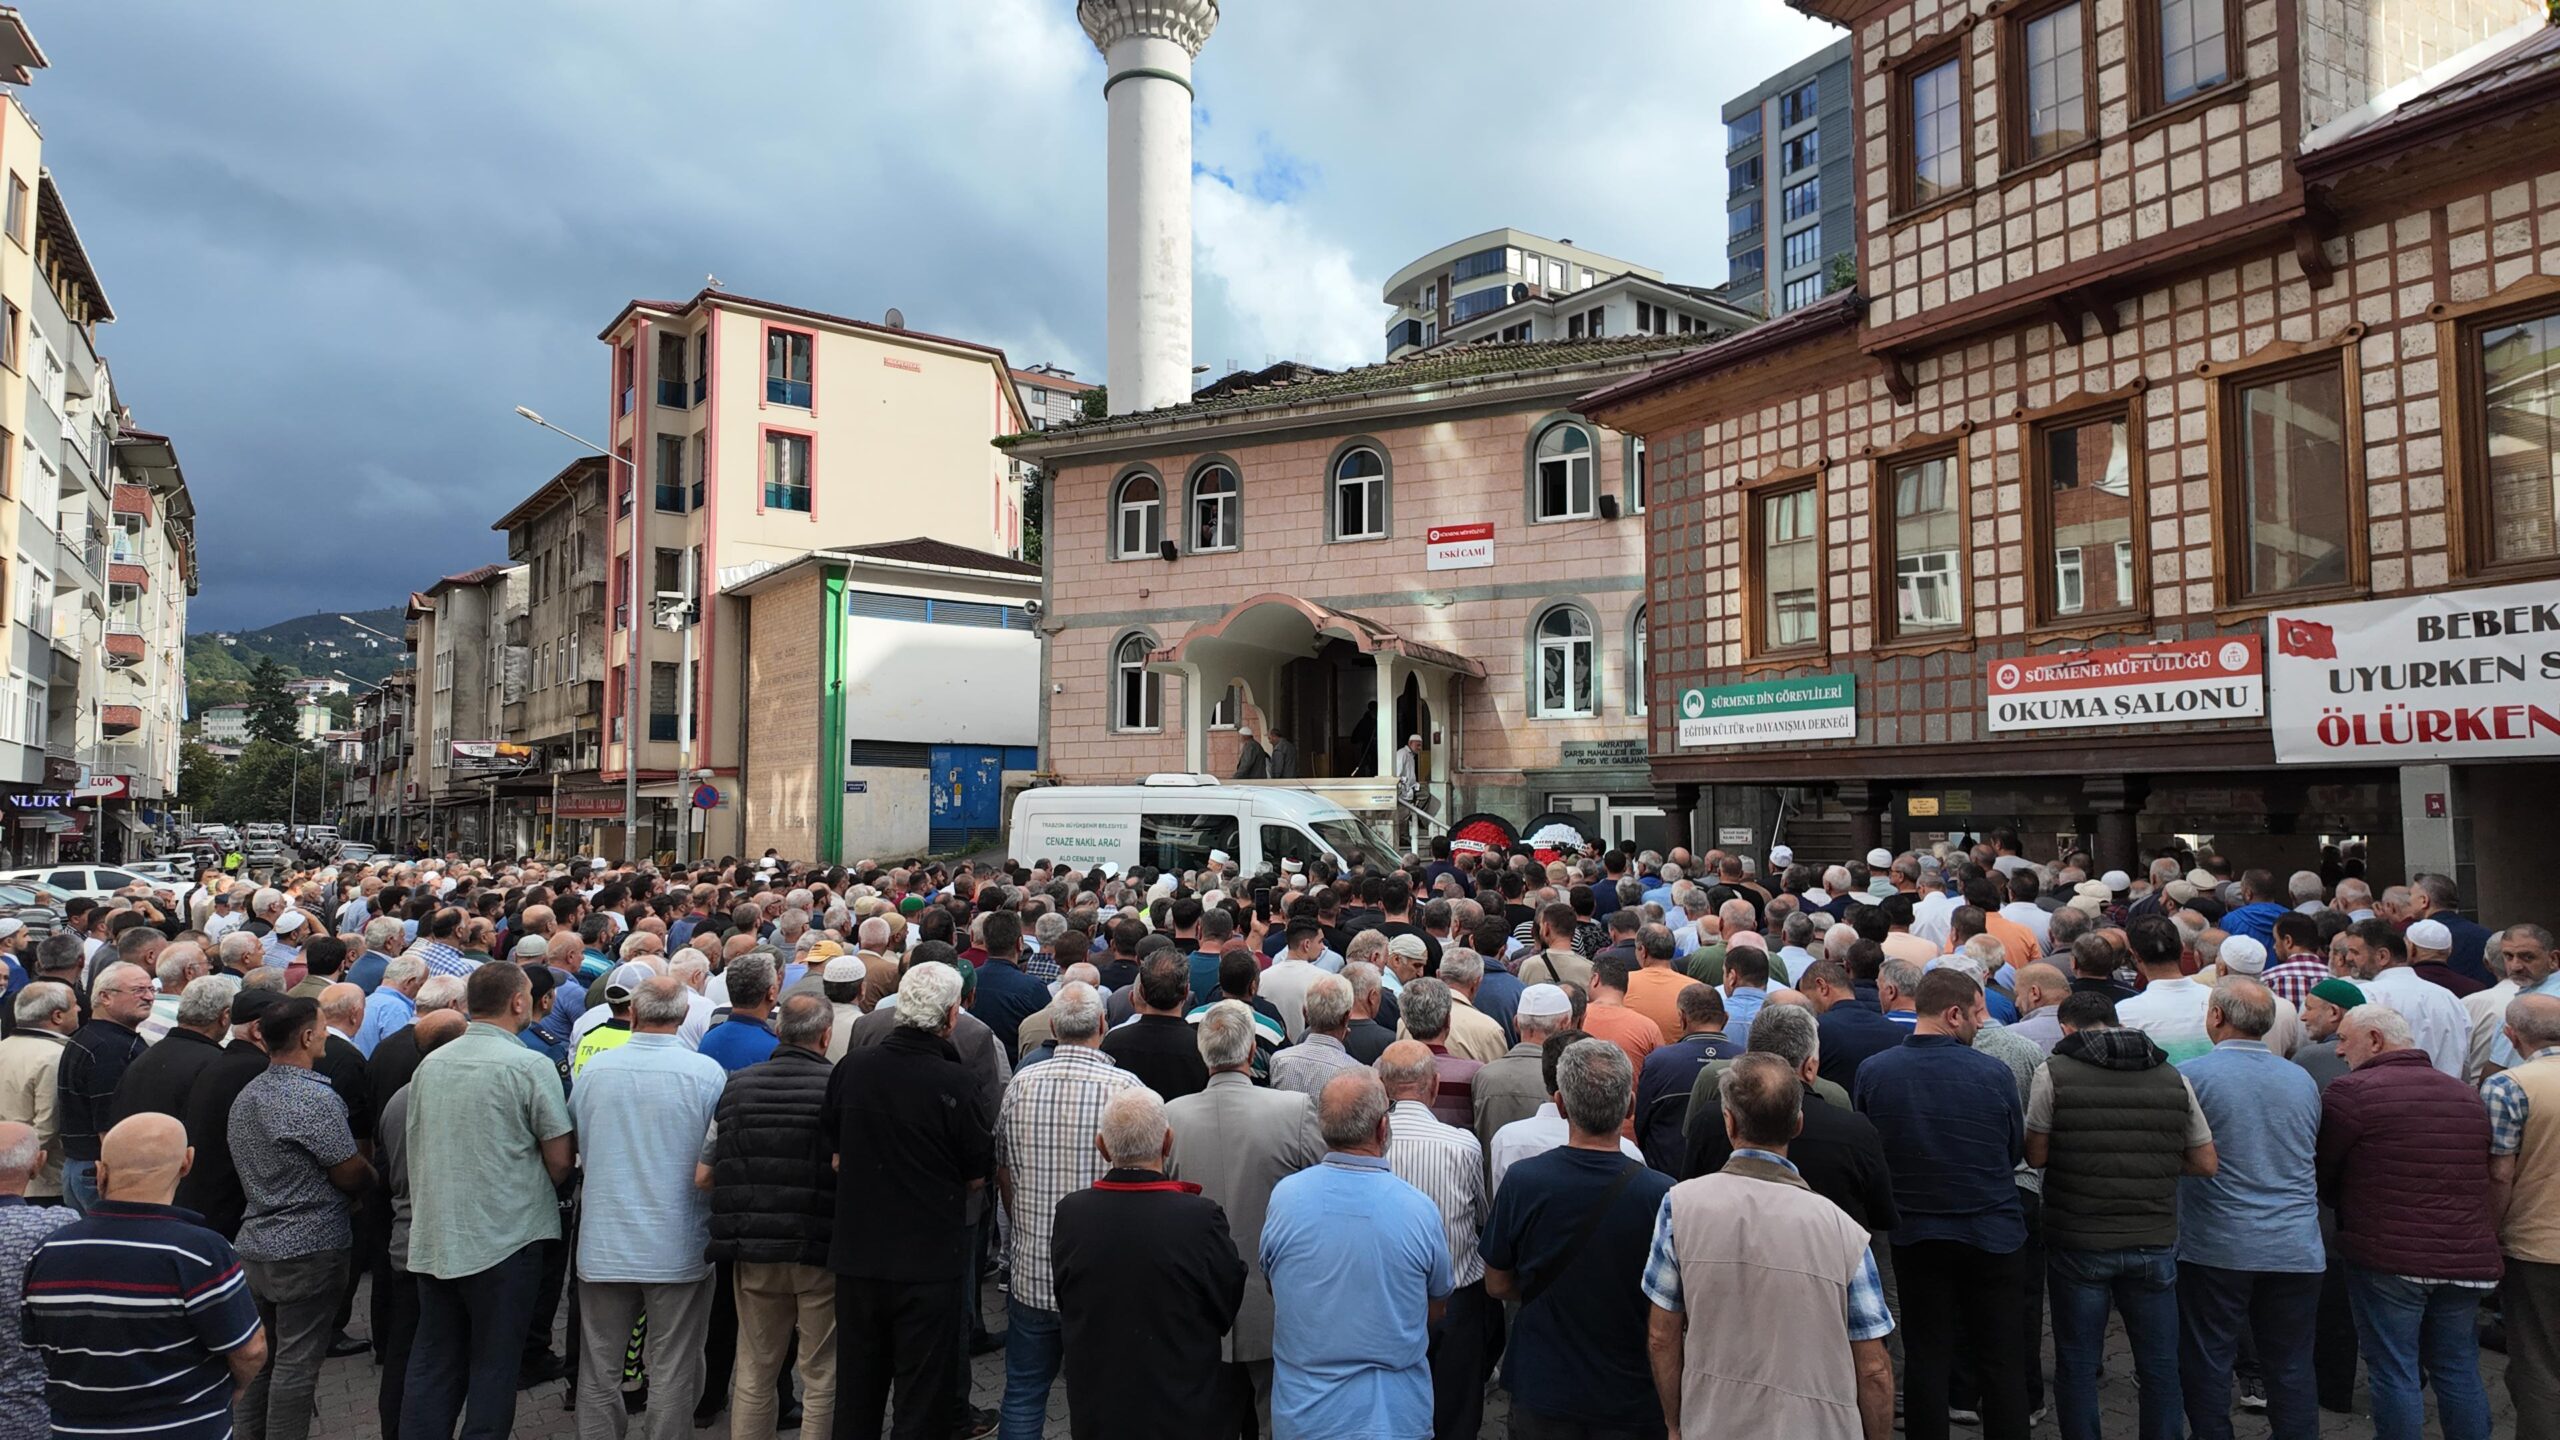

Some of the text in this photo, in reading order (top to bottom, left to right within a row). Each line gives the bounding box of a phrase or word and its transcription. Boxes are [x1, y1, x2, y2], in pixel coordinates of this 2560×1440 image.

[1440, 545, 1485, 559] ESKİ CAMİ
[2417, 603, 2560, 643] BEBEK
[2025, 663, 2101, 683] SÜRMENE
[2329, 654, 2526, 694] UYURKEN
[1711, 684, 1843, 709] SÜRMENE DİN GÖREVLİLERİ
[1998, 686, 2249, 722] OKUMA SALONU
[1684, 714, 1849, 738] EĞİTİM KÜLTÜR ve DAYANIŞMA DERNEĞİ
[2317, 703, 2560, 748] ÖLÜRKEN
[1046, 837, 1121, 848] CENAZE NAKİL ARACI
